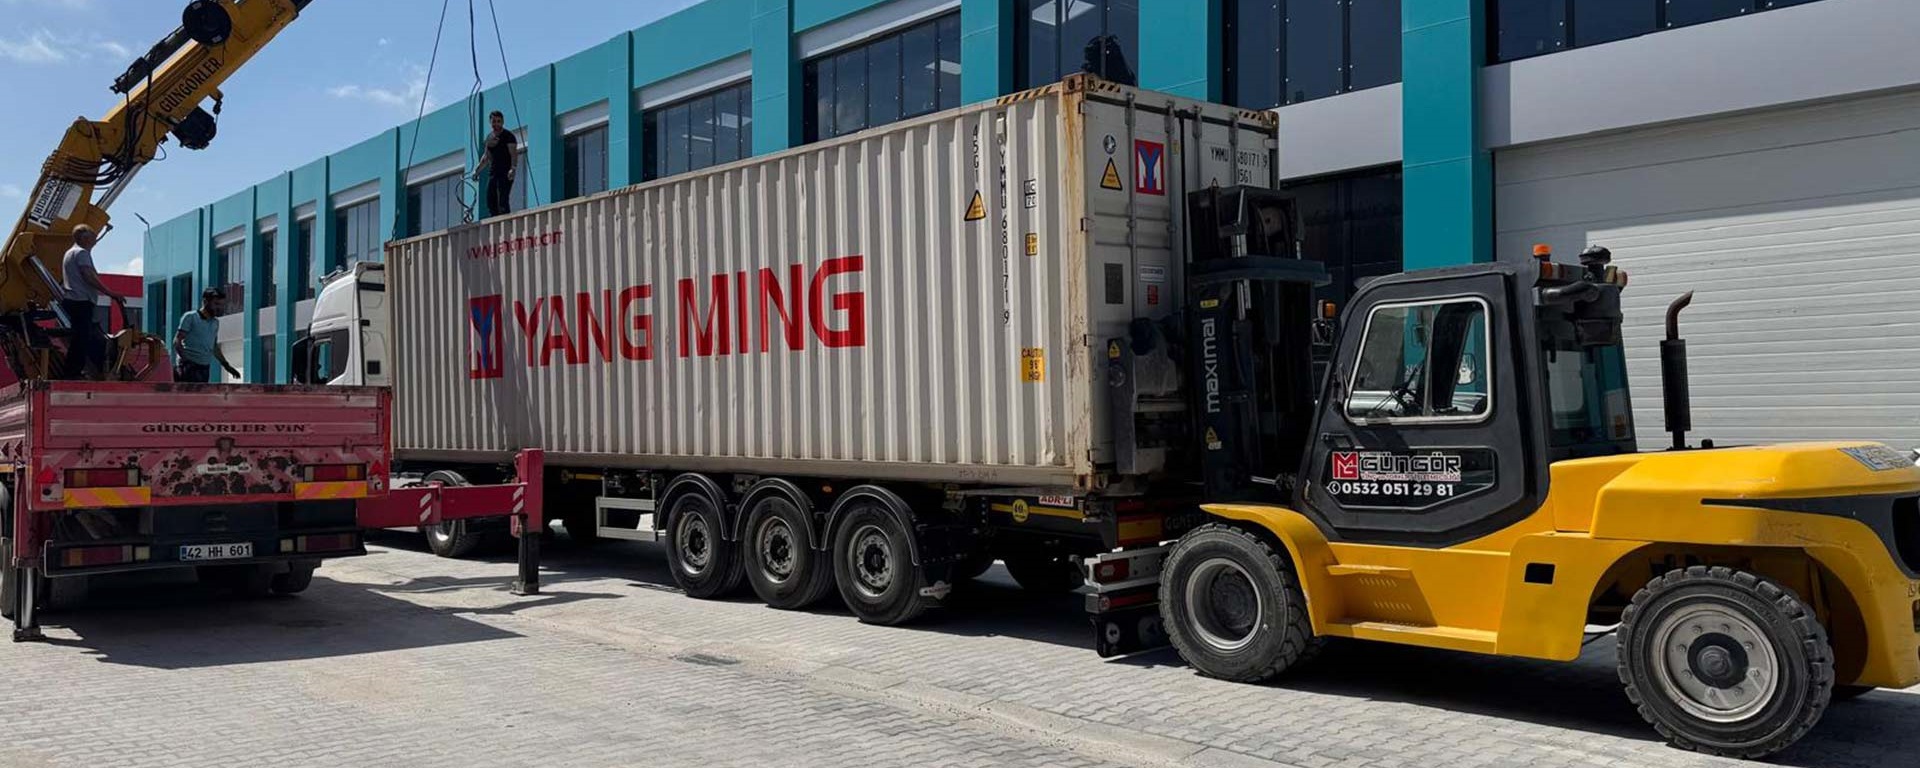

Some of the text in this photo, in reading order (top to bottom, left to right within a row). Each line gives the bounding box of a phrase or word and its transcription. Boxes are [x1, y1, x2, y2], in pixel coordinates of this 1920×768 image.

[1210, 146, 1230, 162] YMMU
[514, 254, 866, 368] YANG MING
[1202, 317, 1220, 414] maximal
[1342, 483, 1454, 496] 0532 051 29 81
[187, 545, 250, 559] 42 HH 601
